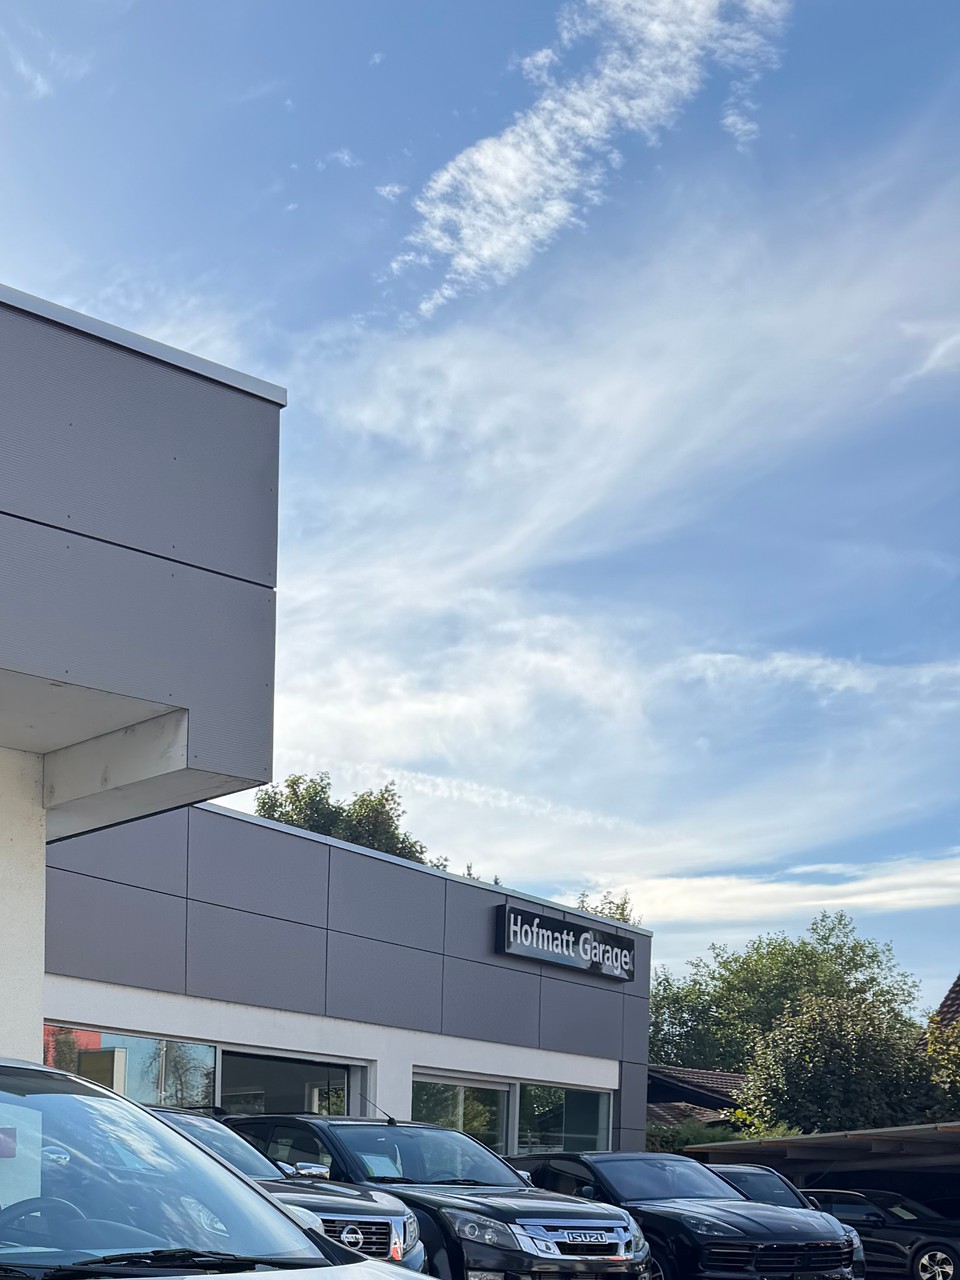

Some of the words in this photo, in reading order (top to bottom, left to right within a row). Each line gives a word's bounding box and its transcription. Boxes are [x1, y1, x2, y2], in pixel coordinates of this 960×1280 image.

[510, 913, 575, 957] Hofmatt
[579, 932, 630, 975] Garage
[568, 1232, 606, 1242] ISUZU
